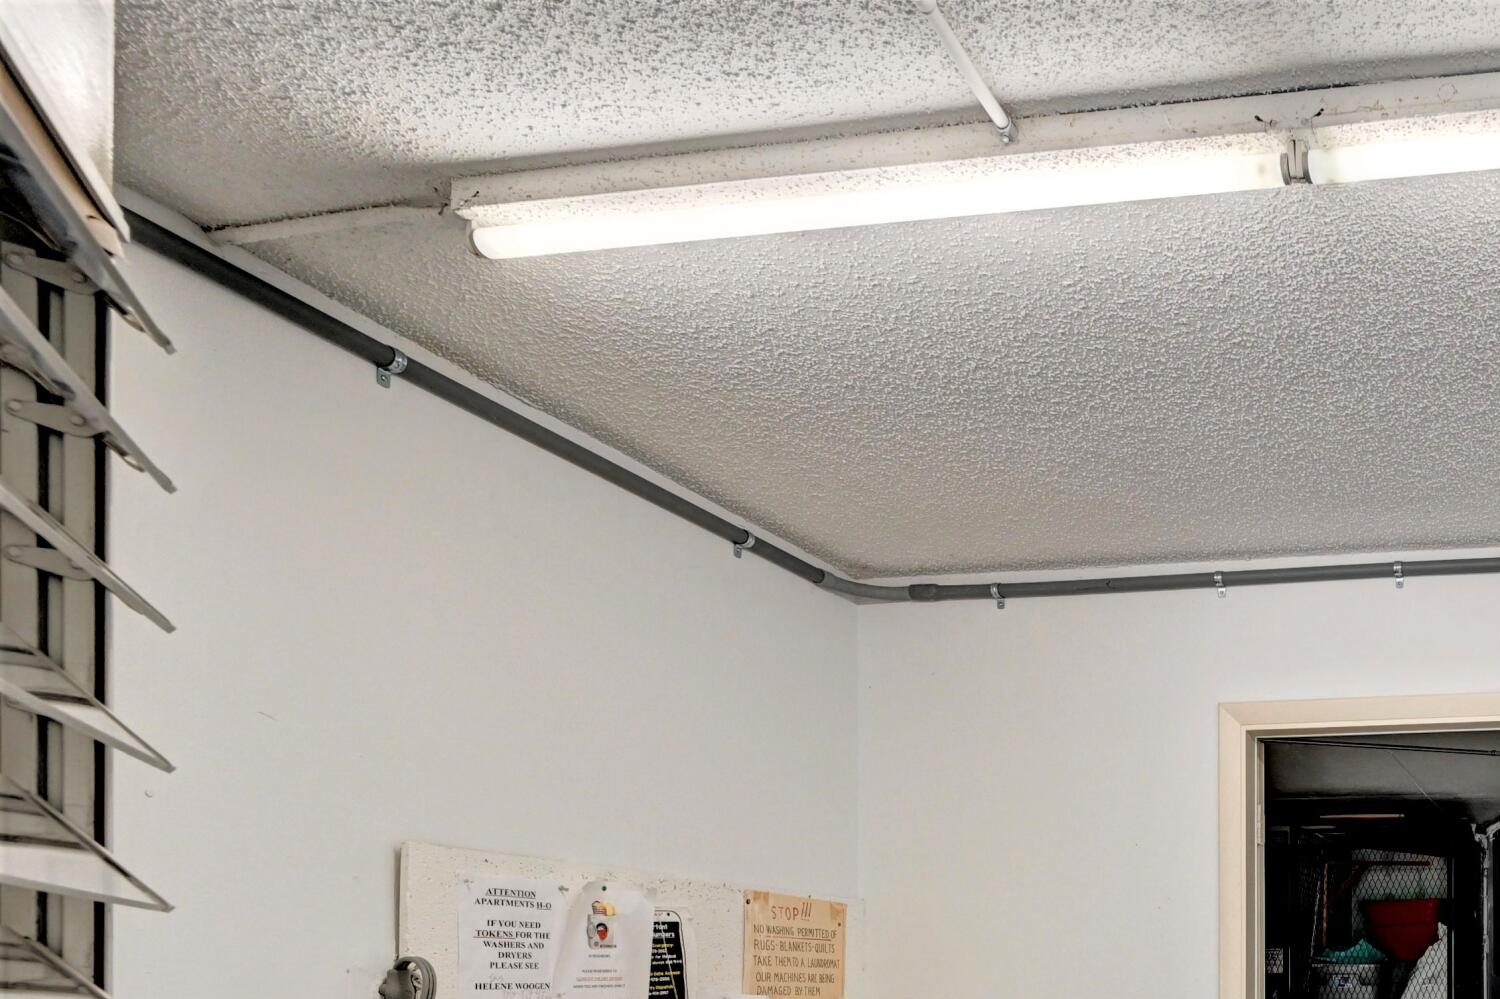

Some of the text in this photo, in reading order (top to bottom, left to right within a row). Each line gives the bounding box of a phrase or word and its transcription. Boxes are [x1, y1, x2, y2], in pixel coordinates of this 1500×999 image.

[485, 888, 537, 899] ATTENTION
[474, 897, 535, 909] APARTMENTS
[487, 919, 541, 929] IF YOU NEED
[474, 929, 551, 940] TOKENS FOR THE
[753, 924, 838, 939] NO WASHING PERMITTED OF
[482, 940, 545, 950] WASHERS AND
[498, 951, 532, 960] DRYERS
[489, 961, 540, 970] PLEASE SEE
[753, 954, 773, 967] TAKE
[775, 956, 792, 967] THEM
[807, 959, 840, 969] LAUNDROMAT
[756, 971, 835, 984] OUR MACHINES ARE BEING
[474, 982, 514, 991] HELENE
[756, 985, 821, 997] DAMAGED BY THEM
